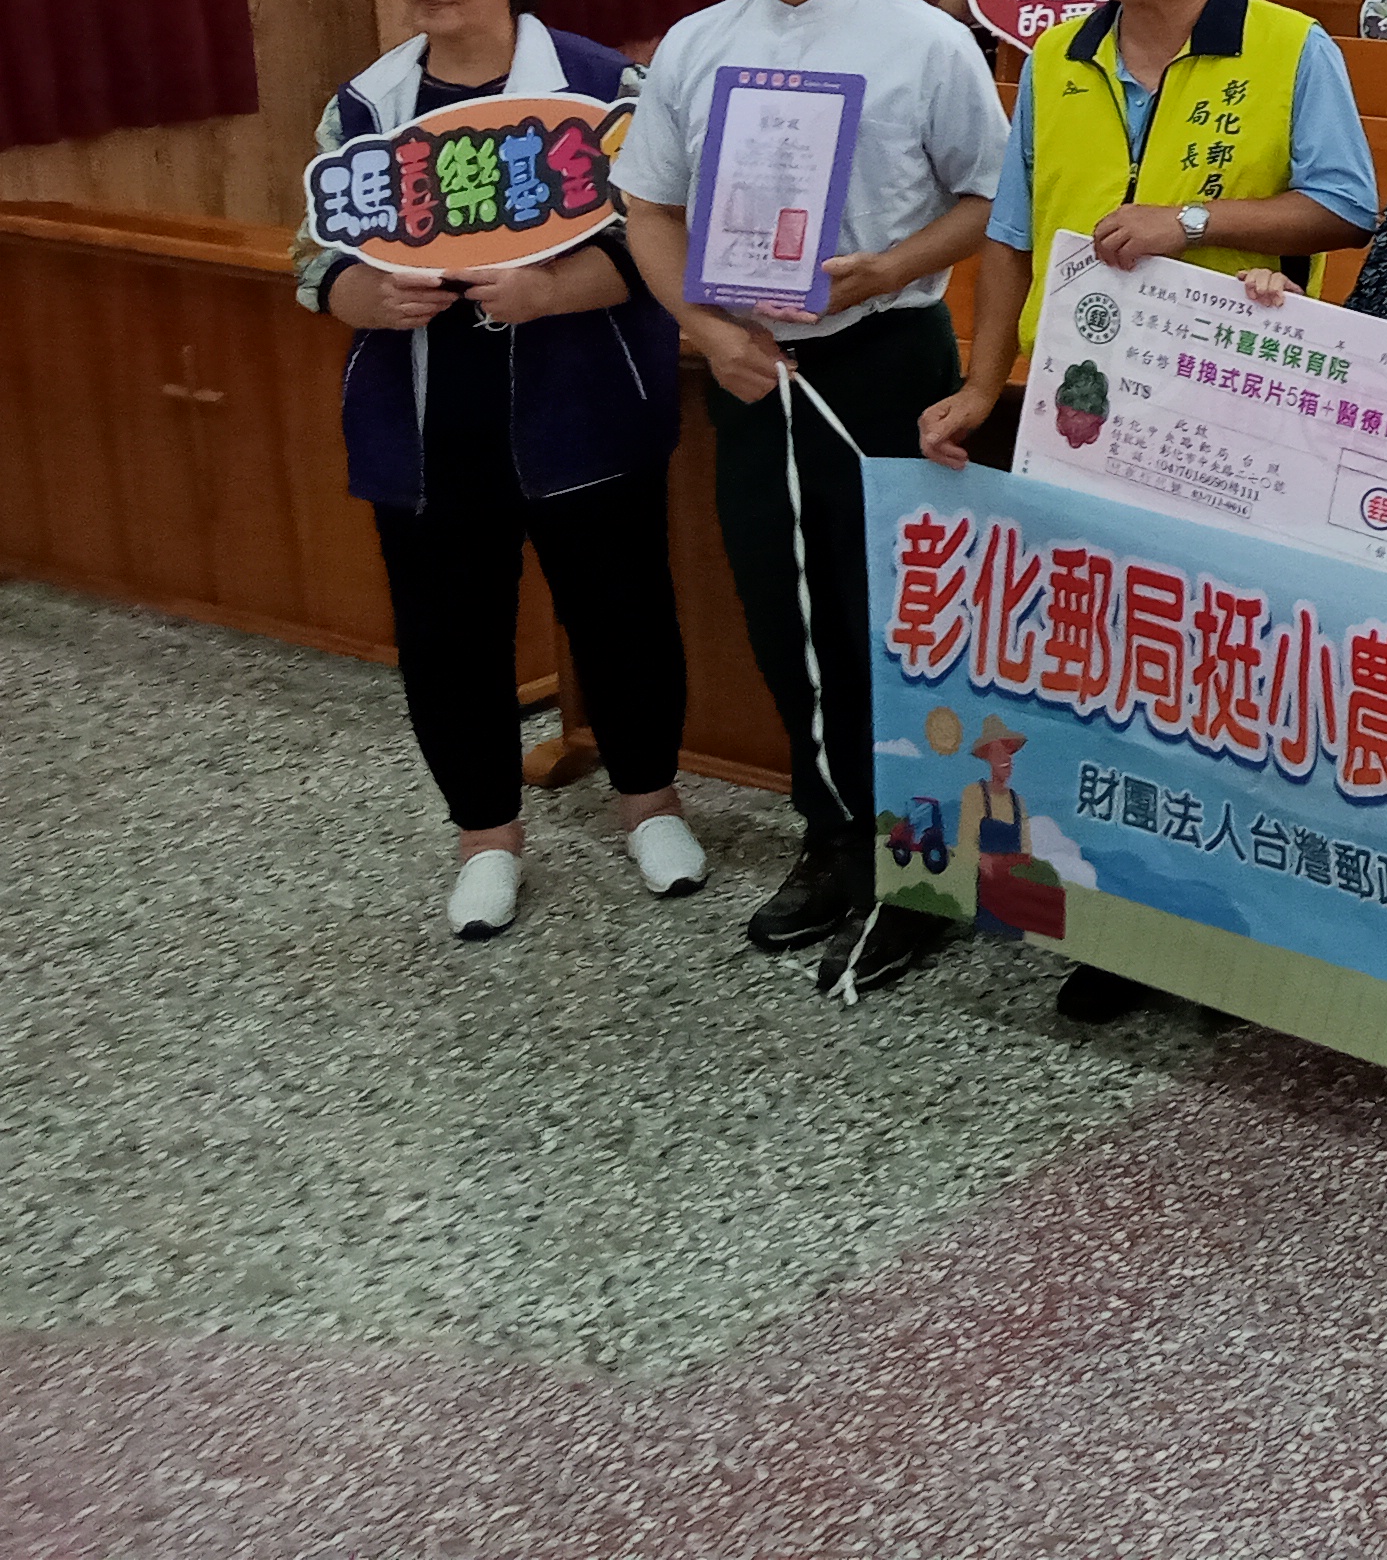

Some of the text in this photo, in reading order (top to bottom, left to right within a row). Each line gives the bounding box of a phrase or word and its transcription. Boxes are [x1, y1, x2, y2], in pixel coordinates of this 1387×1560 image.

[1179, 100, 1211, 171] 局長
[1196, 78, 1251, 200] 彰化郵局
[317, 111, 633, 241] 瑪喜樂基金
[1060, 253, 1100, 282] Ban
[1190, 316, 1352, 385] 二林喜樂保育院
